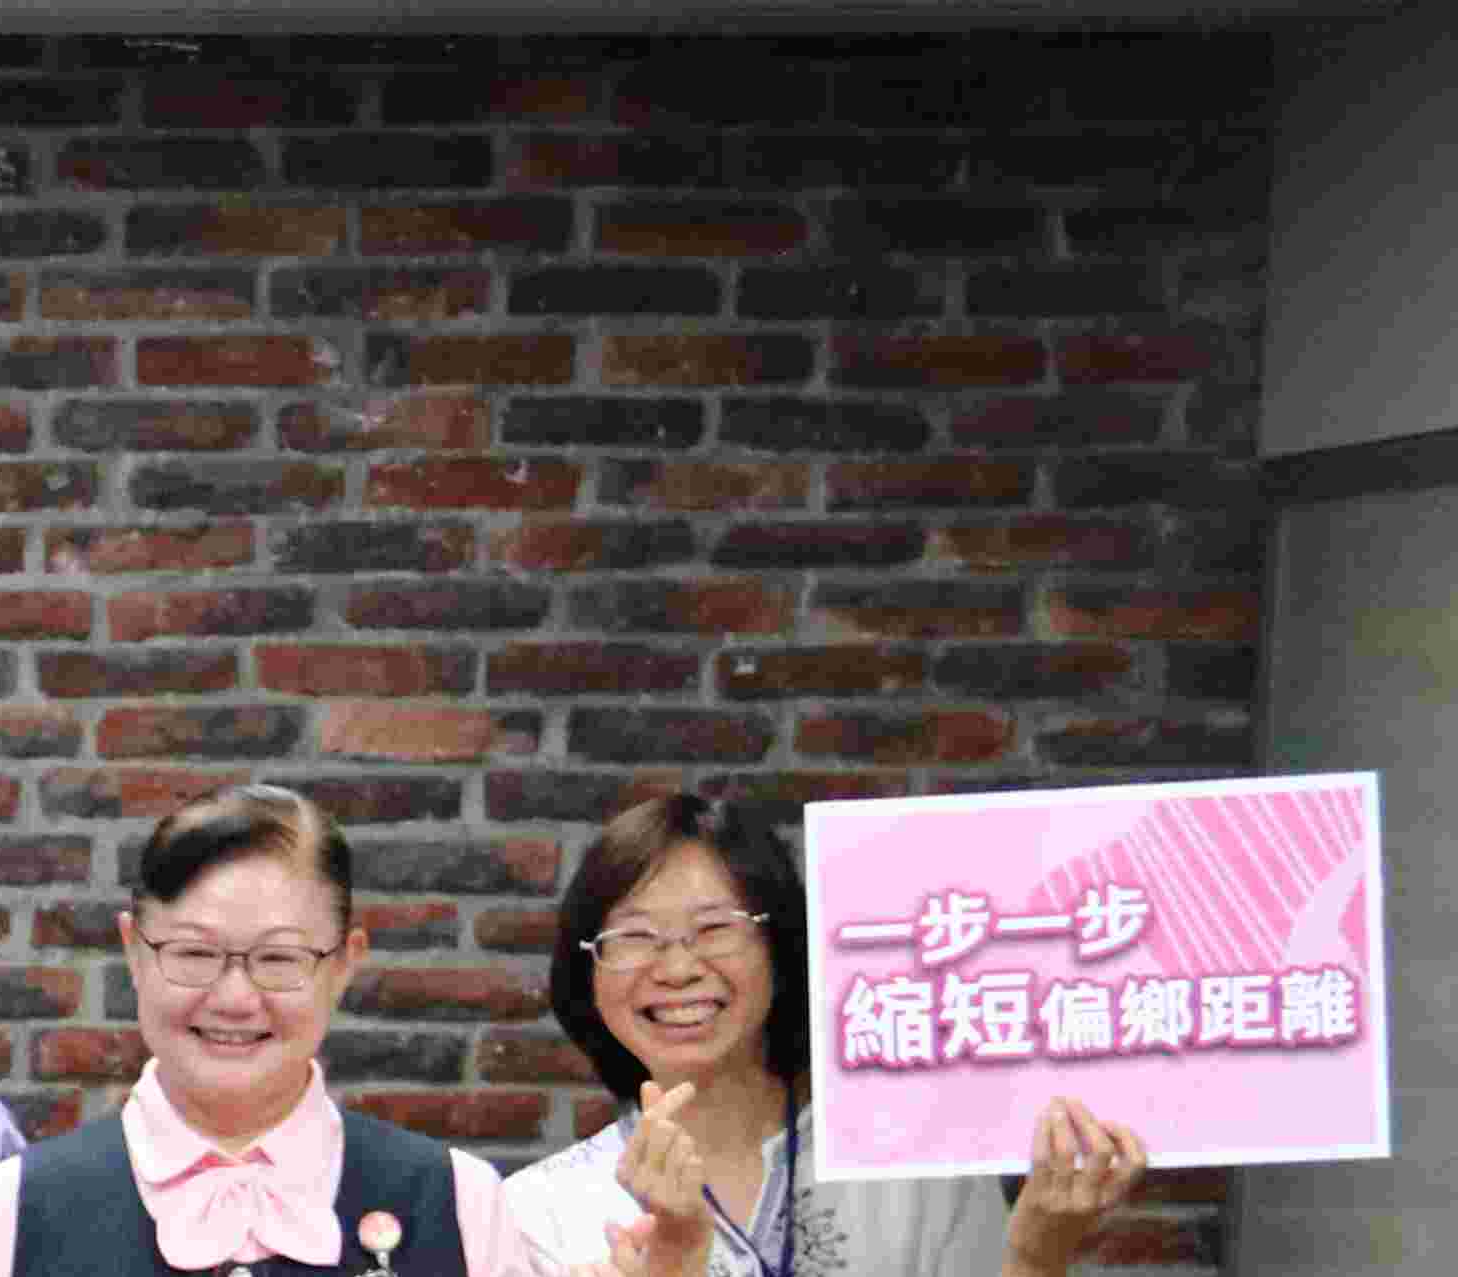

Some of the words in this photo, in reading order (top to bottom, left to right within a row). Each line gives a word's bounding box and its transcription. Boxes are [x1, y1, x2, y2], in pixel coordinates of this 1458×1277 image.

[837, 884, 1149, 966] 一步一步
[842, 966, 1359, 1067] 縮短偏鄉距離
